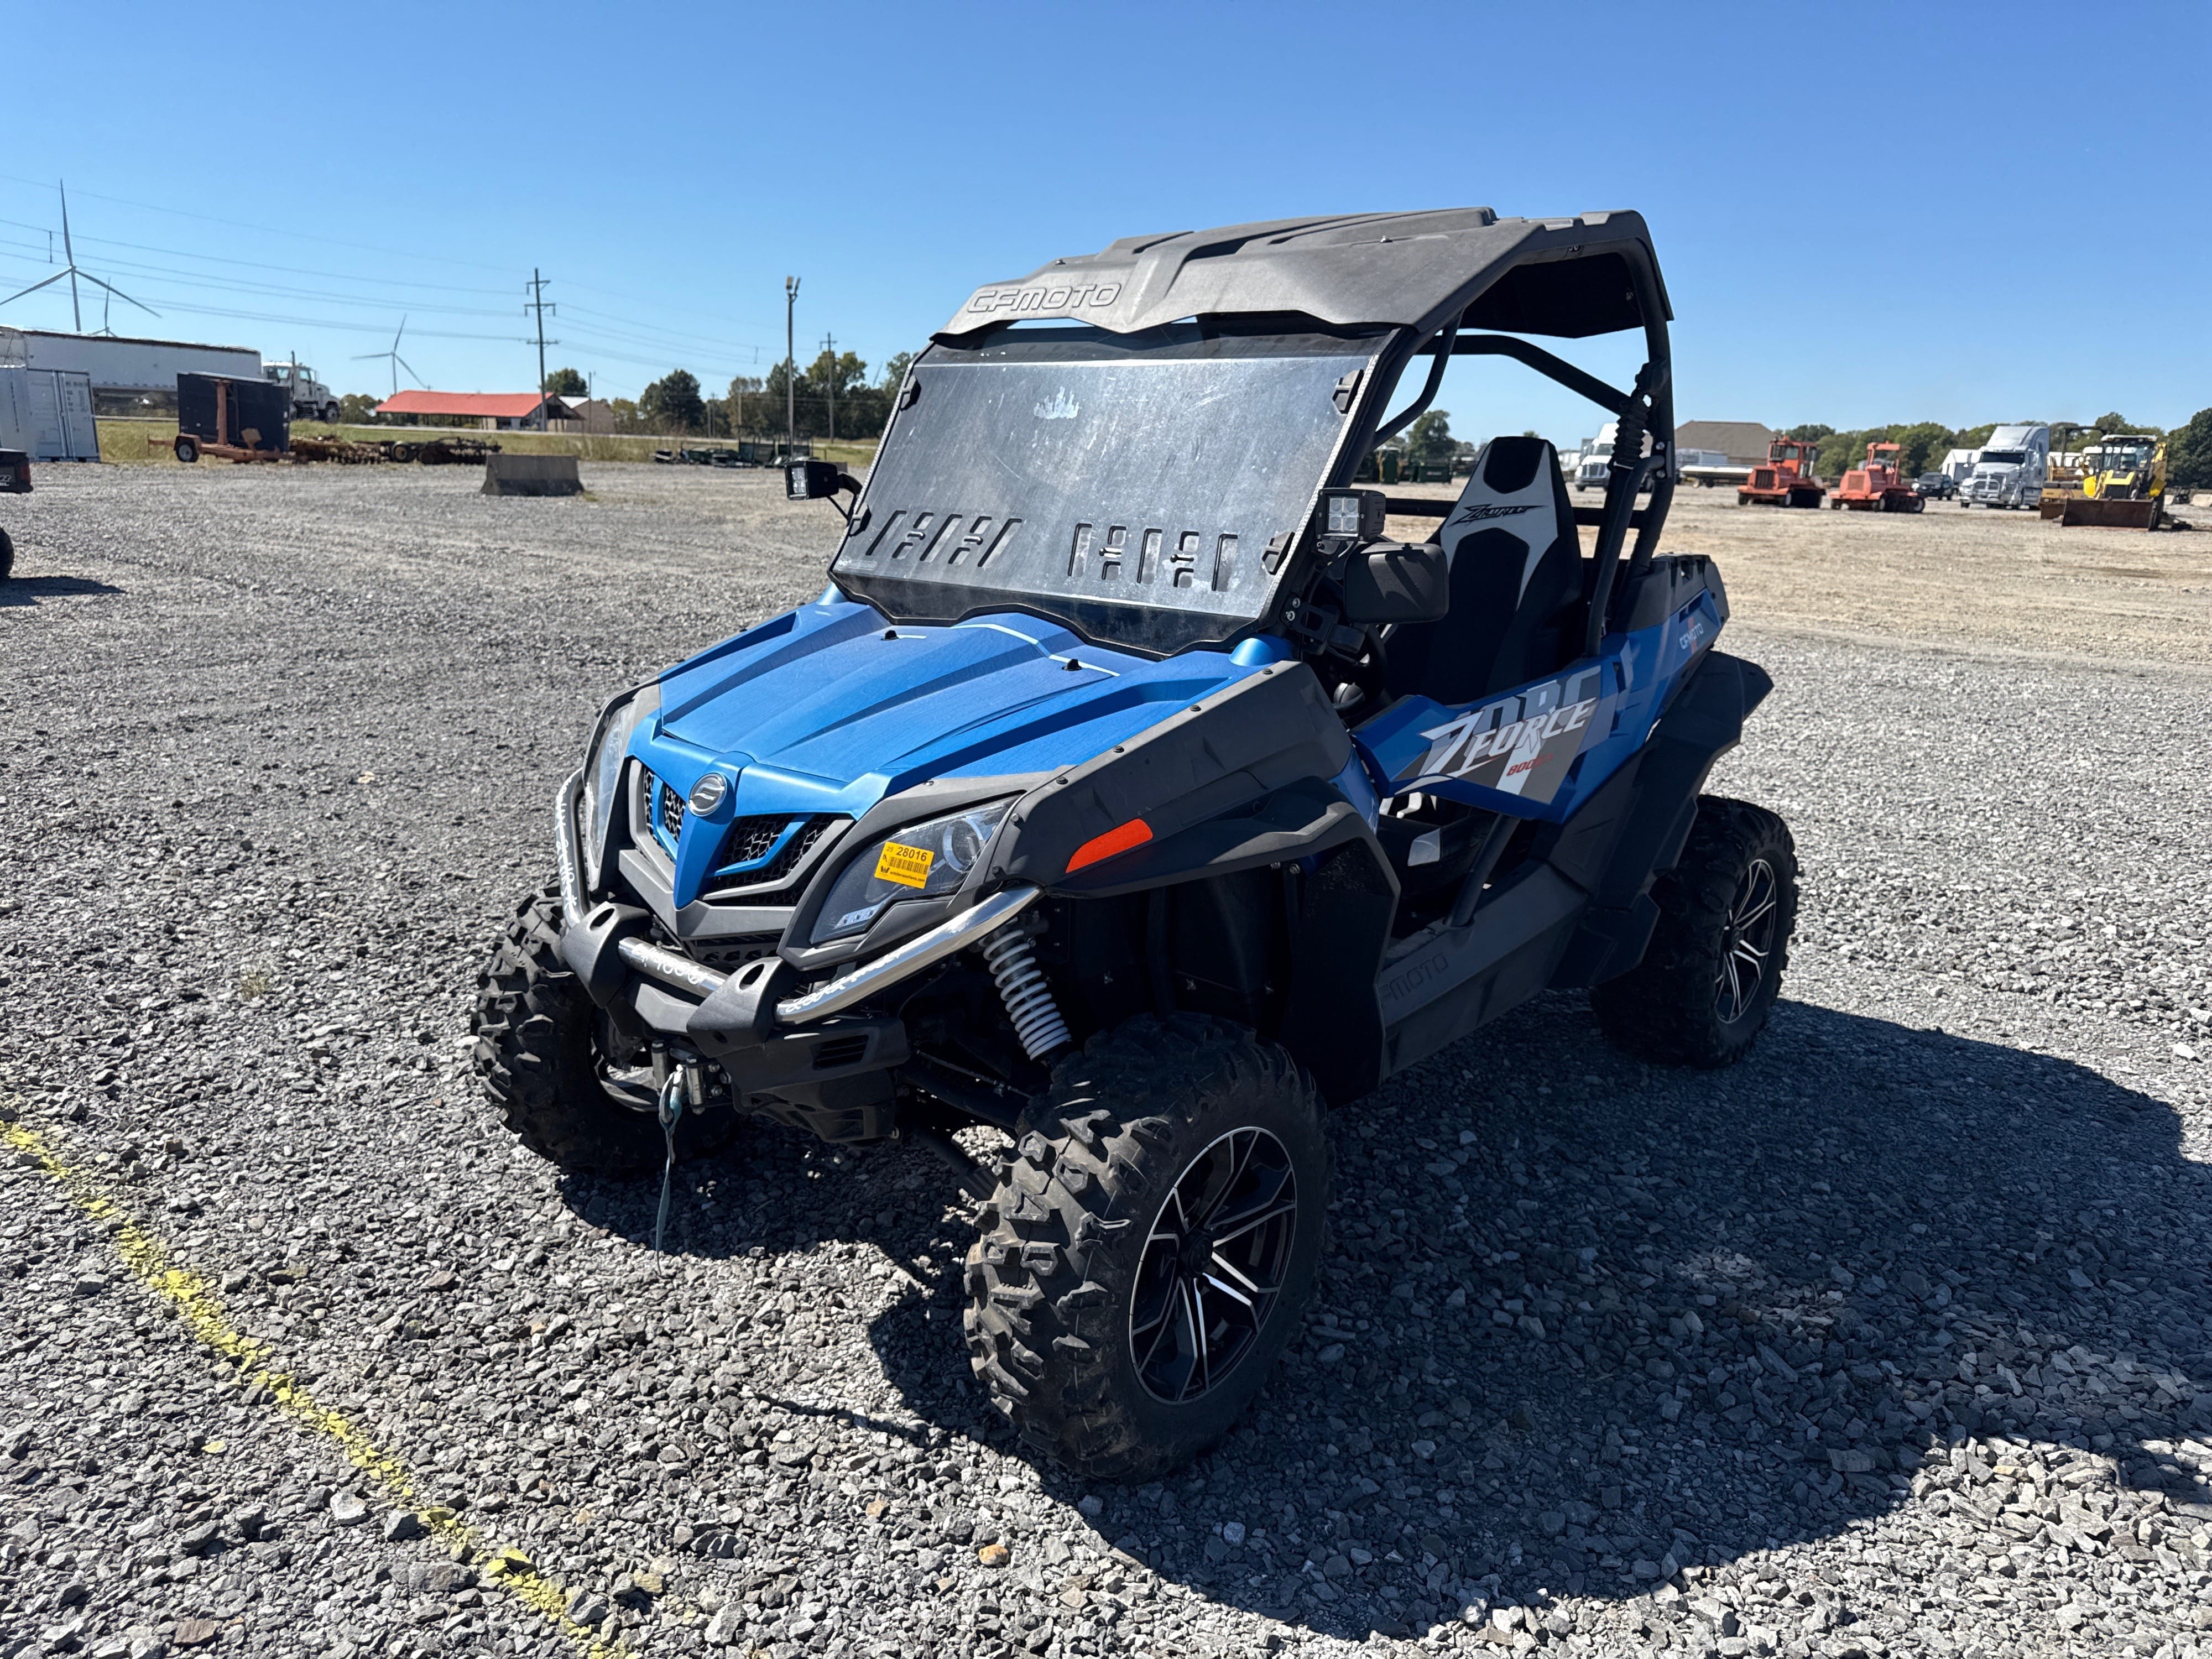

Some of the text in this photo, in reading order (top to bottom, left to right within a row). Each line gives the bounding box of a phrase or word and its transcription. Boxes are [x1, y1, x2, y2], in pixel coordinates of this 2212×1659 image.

[968, 283, 1122, 313] CFMOTO
[1679, 623, 1704, 650] CFMOTO
[896, 847, 927, 862] 28016
[1378, 952, 1449, 1001] FMOTO
